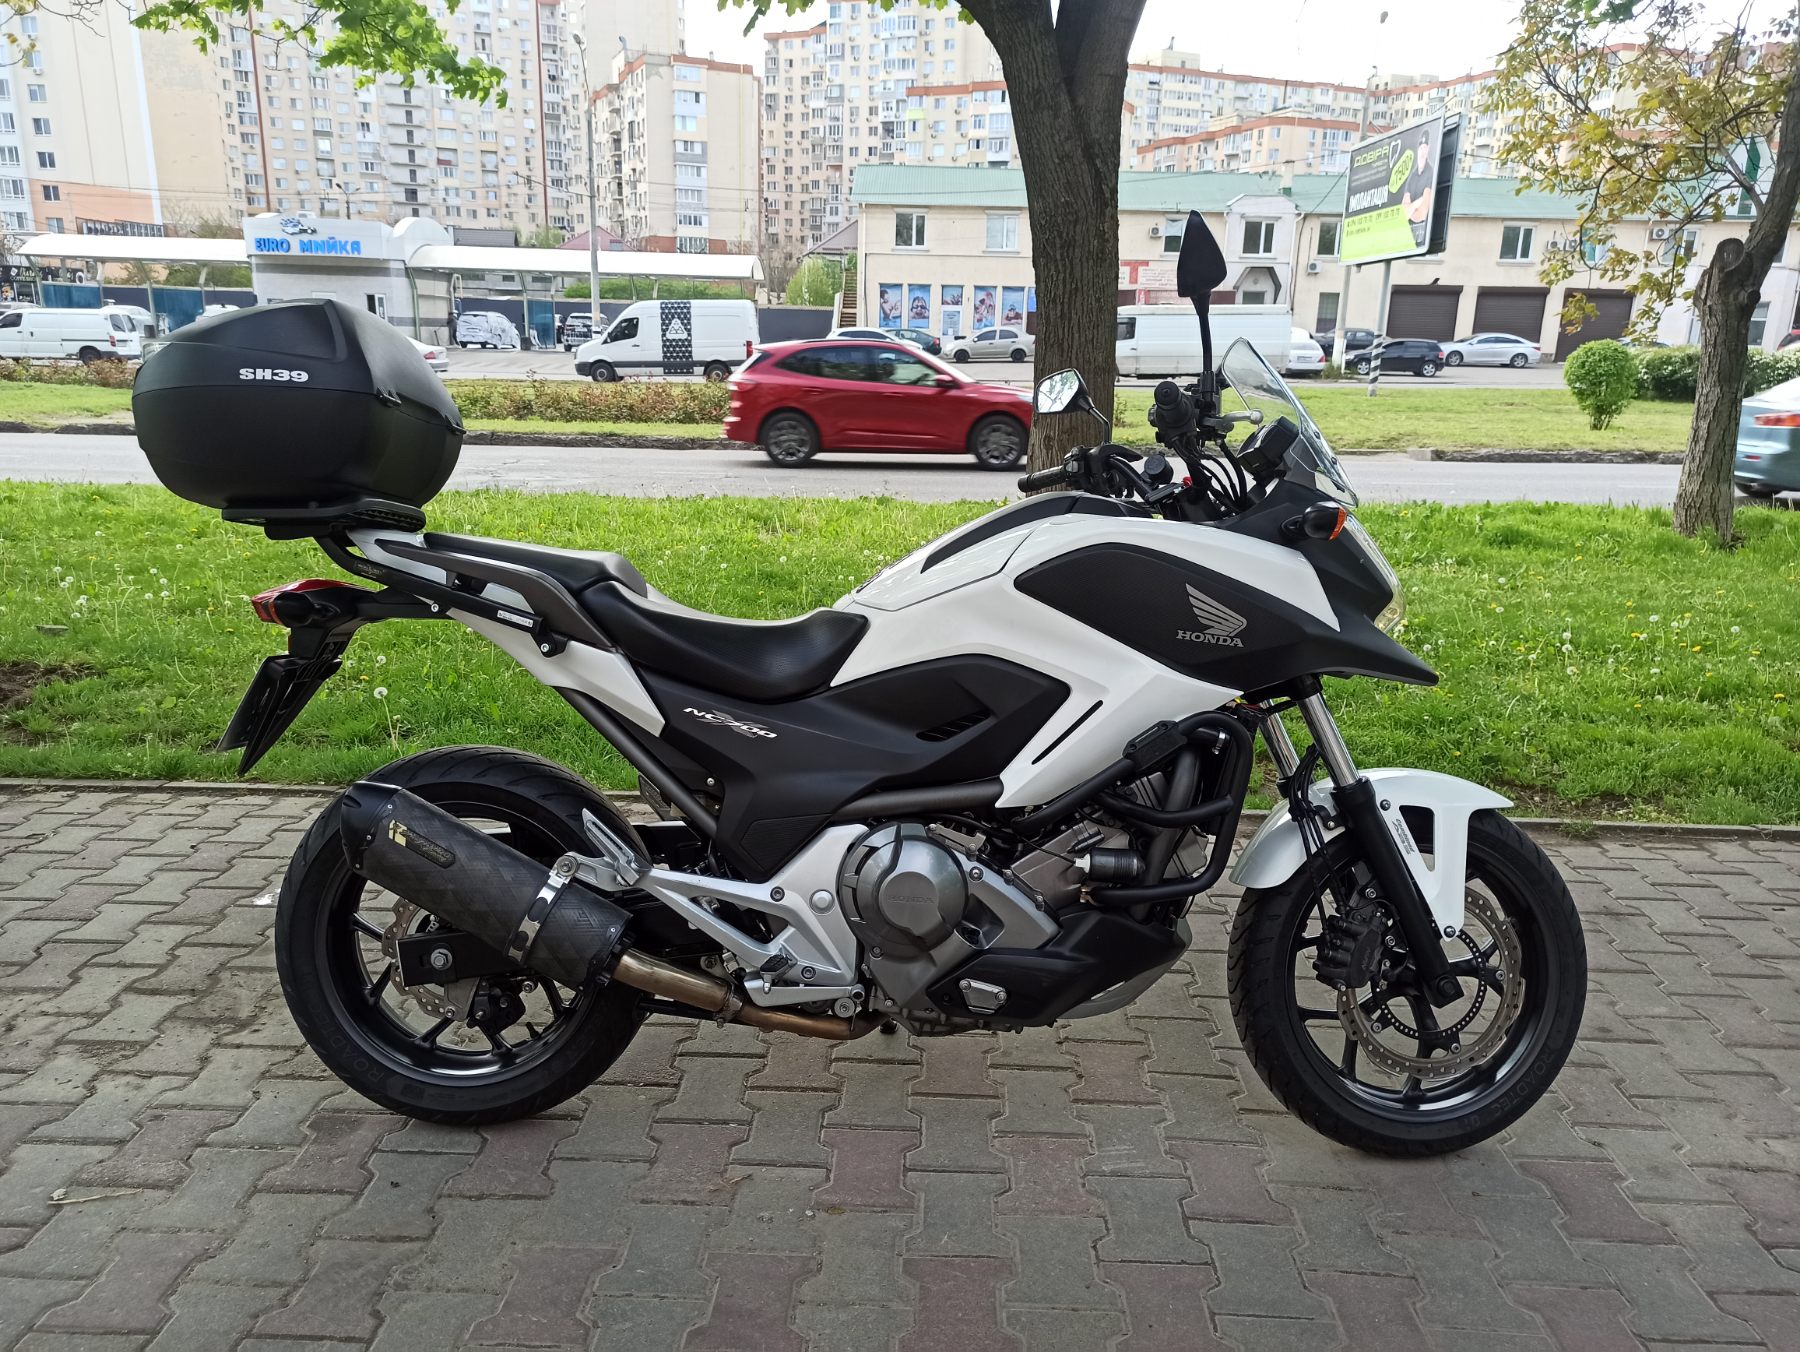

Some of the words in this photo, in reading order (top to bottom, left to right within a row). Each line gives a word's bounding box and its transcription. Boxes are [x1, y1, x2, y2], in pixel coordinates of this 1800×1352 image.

[255, 238, 291, 253] EURO
[239, 368, 309, 383] SH39
[1176, 630, 1244, 648] HONDA
